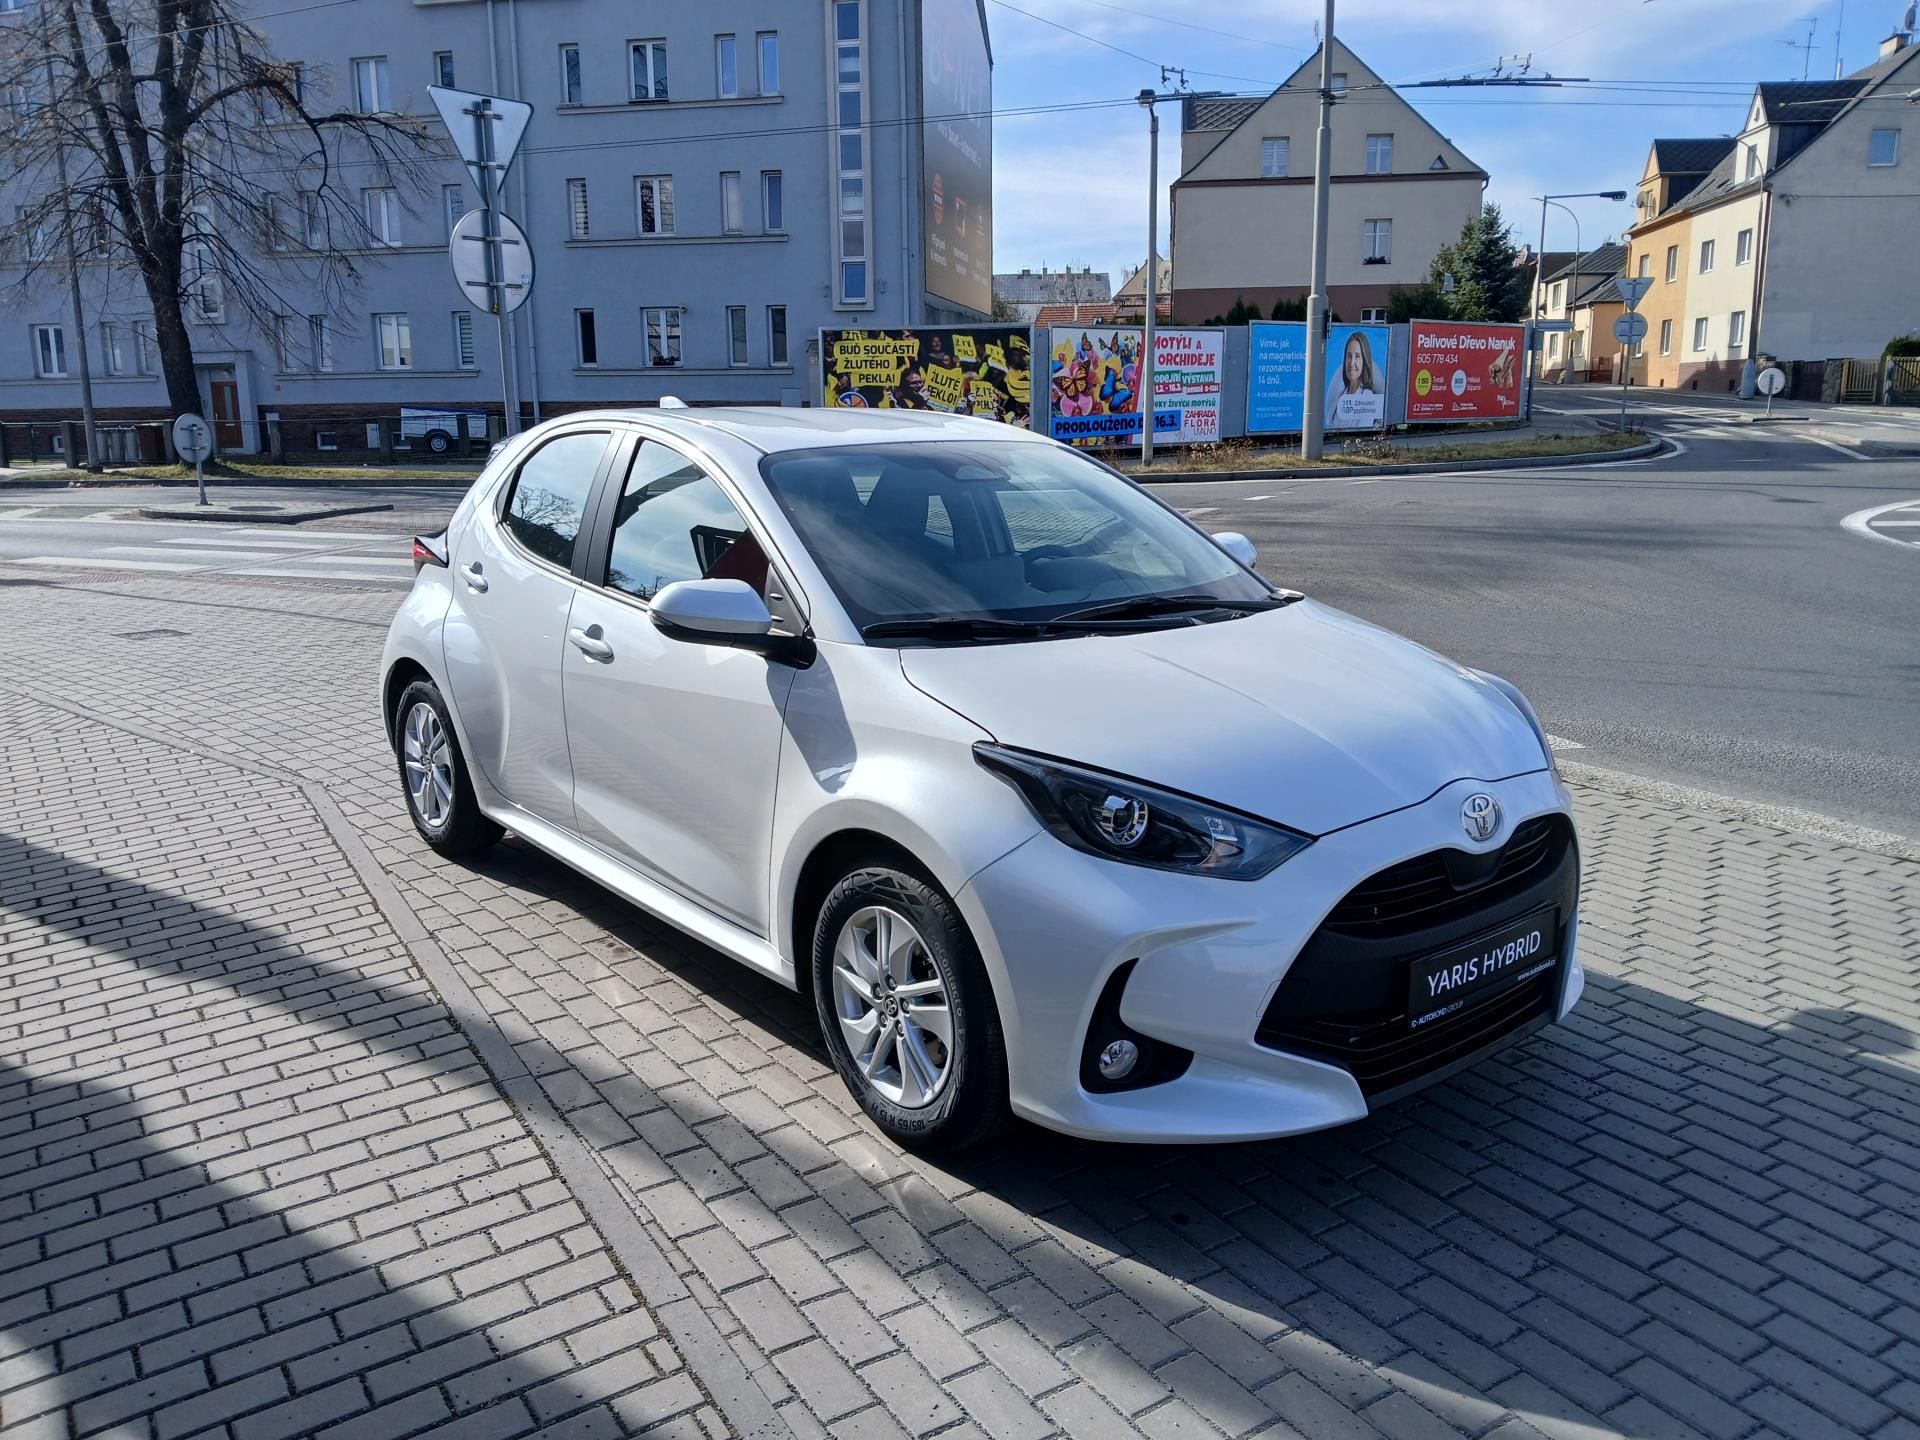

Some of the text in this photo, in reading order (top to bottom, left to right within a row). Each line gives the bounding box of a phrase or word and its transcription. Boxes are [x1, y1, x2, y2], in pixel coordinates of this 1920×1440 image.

[1196, 341, 1202, 350] A
[1280, 339, 1290, 350] jak
[1417, 334, 1515, 350] Palivové Dřevo Nanuk
[840, 342, 915, 355] BUĎ SOUČÁSTÍ
[1157, 353, 1216, 366] ORCHIDEJE
[1269, 352, 1307, 363] magneticko
[1417, 353, 1458, 363] 605 778 434
[843, 357, 890, 370] ŽLUTÉHO
[1258, 363, 1301, 372] rezonanci do
[1154, 373, 1214, 384] ODEJNÍ VÝSTAVA
[1258, 376, 1265, 385] 14
[1184, 410, 1216, 419] ZAHRADA
[1154, 414, 1177, 428] 16.3.
[1184, 419, 1216, 427] FLORA
[815, 898, 835, 979] ontinental
[1427, 930, 1542, 997] YARIS HYBRID
[898, 1119, 927, 1132] 185/65
